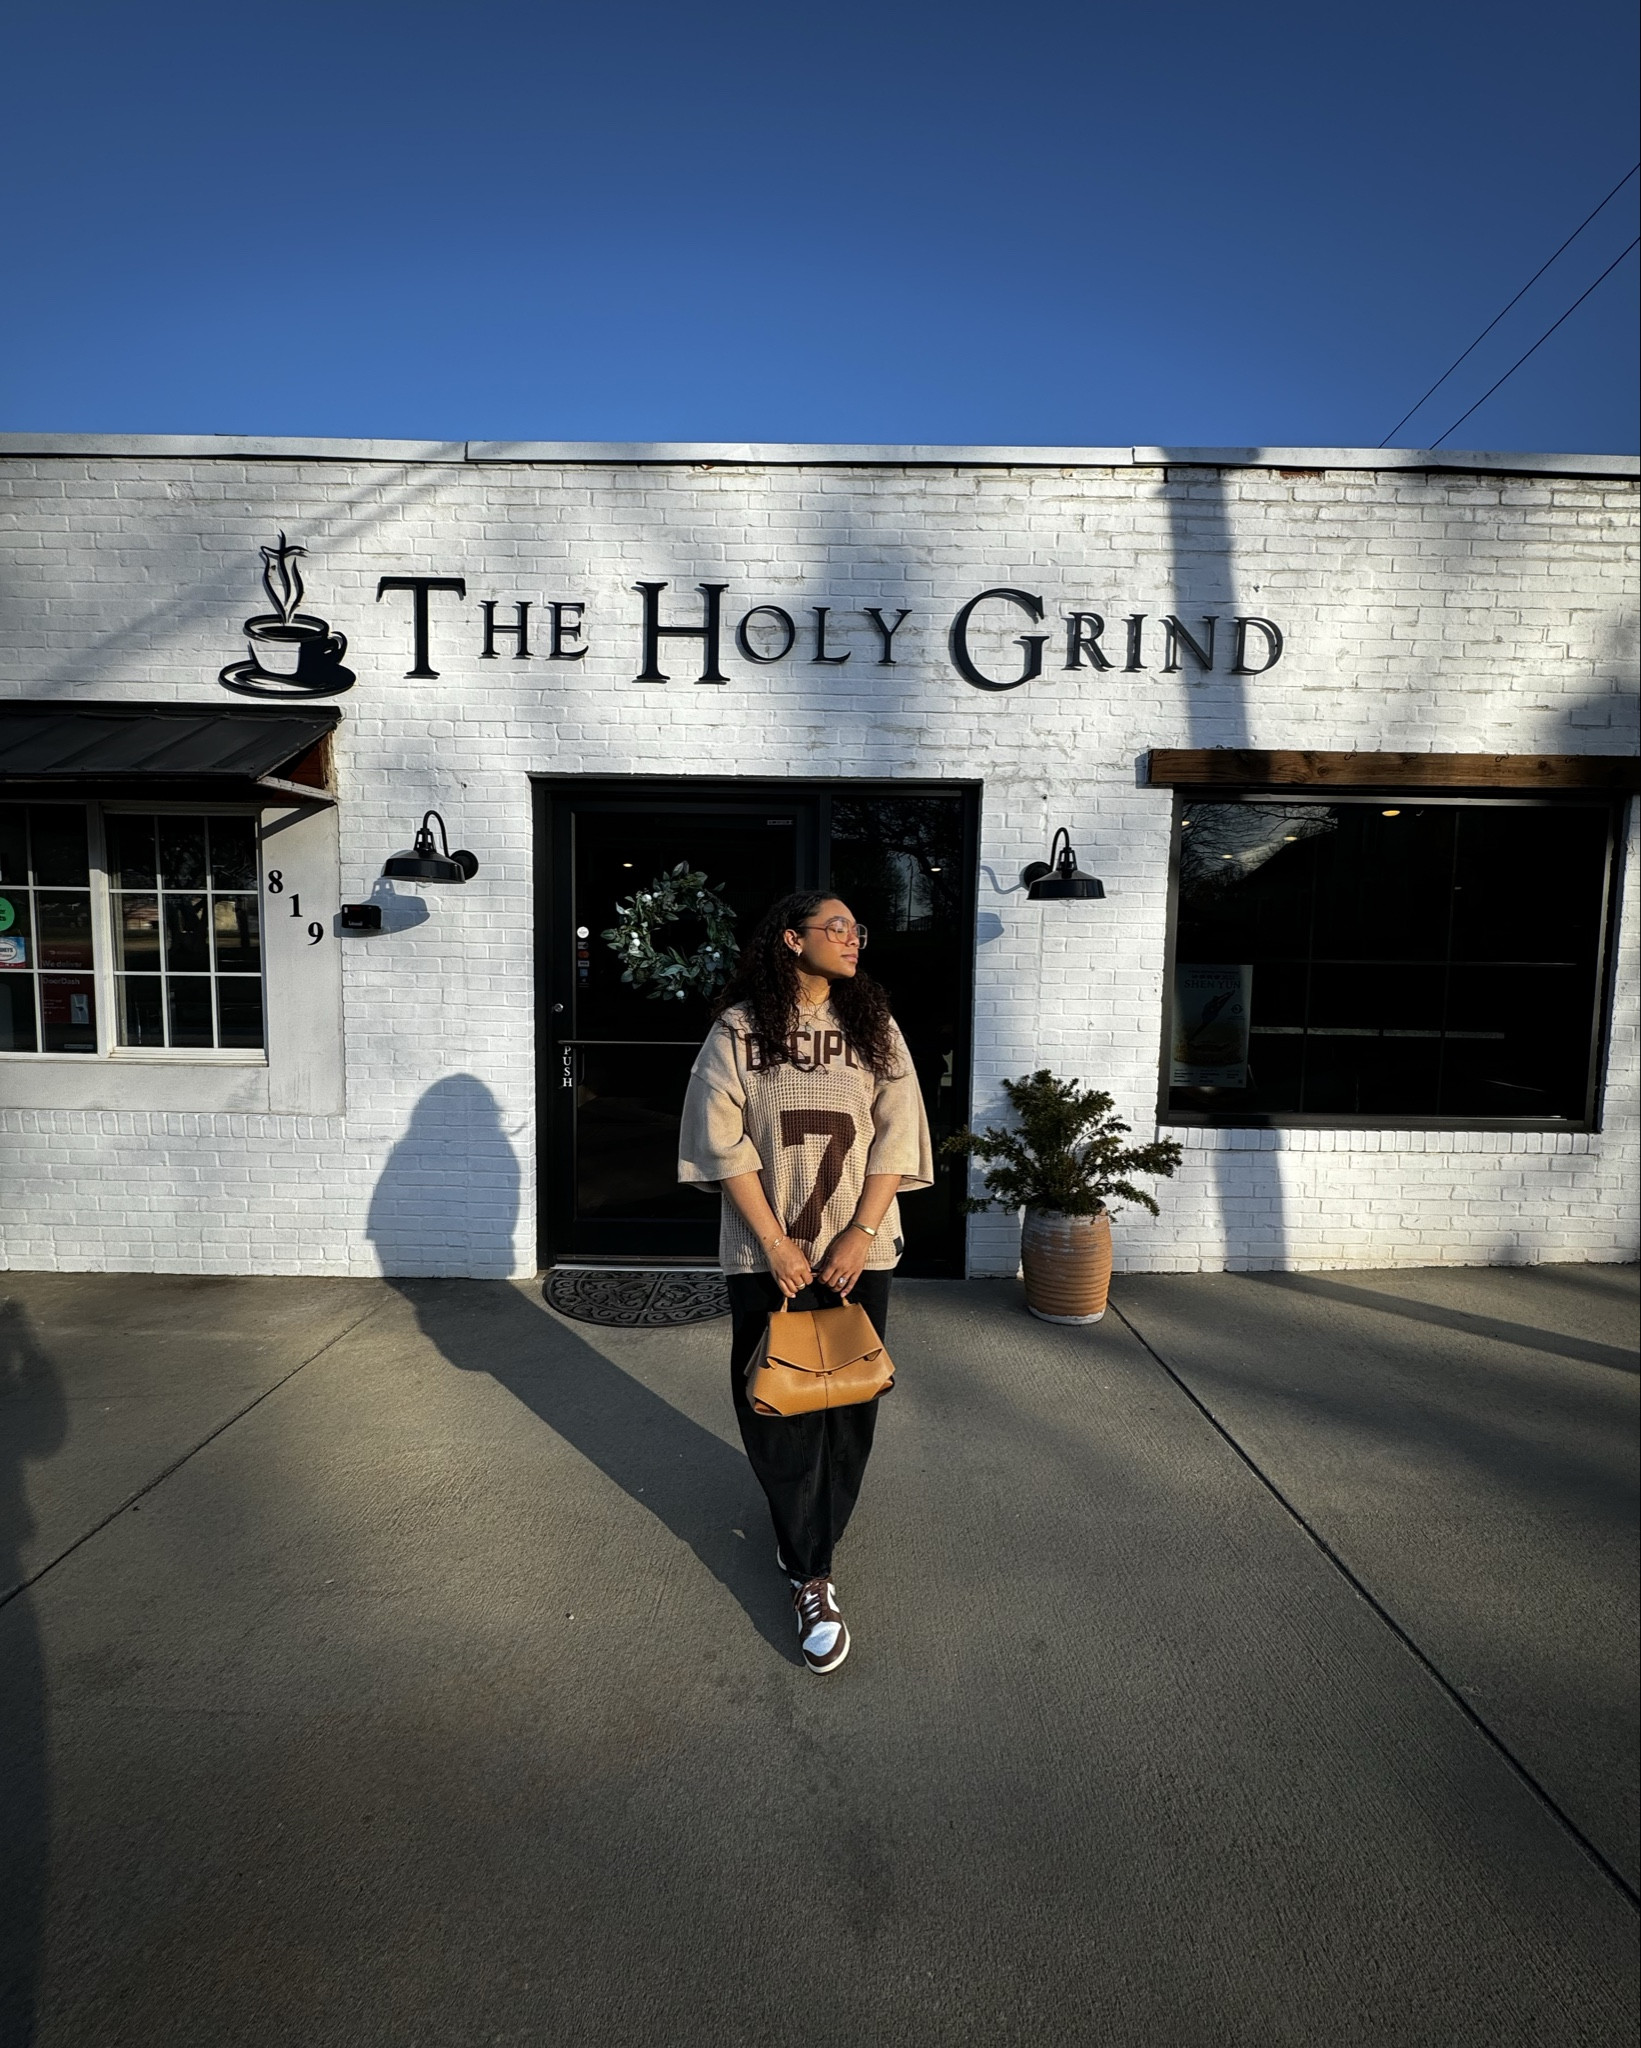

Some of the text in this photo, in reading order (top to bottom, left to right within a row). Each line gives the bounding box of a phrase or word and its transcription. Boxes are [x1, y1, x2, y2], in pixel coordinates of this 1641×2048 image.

[377, 577, 1284, 689] THE HOLY GRIND
[1184, 979, 1241, 989] SHEN YUN
[562, 1045, 573, 1087] PUSH
[780, 1109, 857, 1243] 7
